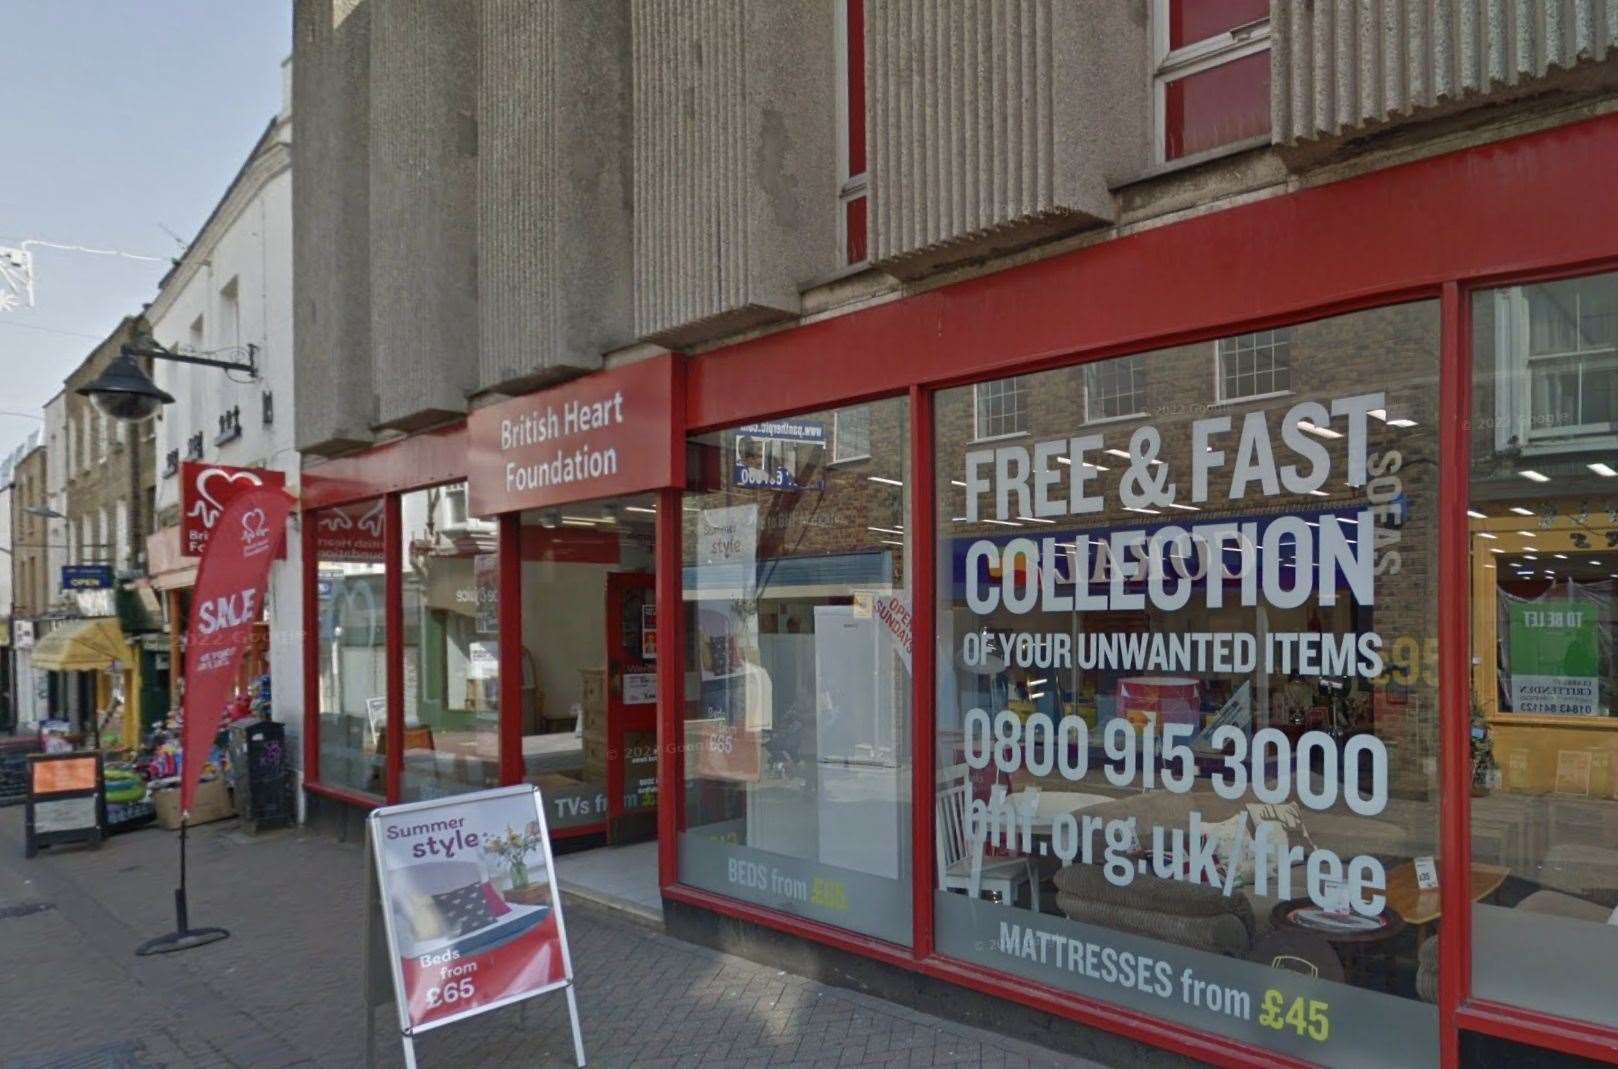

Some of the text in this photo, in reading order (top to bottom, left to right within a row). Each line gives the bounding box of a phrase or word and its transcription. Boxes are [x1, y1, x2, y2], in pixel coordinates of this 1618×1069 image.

[501, 392, 624, 450] British Heart
[505, 447, 617, 492] Foundation
[965, 392, 1385, 523] FREE & FAST
[965, 507, 1374, 615] COLLECTION
[197, 588, 257, 634] SALE
[875, 600, 913, 654] SUNDAYS
[889, 598, 912, 628] OPE
[963, 632, 1384, 679] OF YOUR UNWANTED ITEMS
[964, 707, 1388, 816] 0800 915 3000
[387, 817, 465, 840] Summer
[554, 796, 591, 819] TVs
[413, 830, 480, 858] style
[964, 783, 1386, 917] bhf.org.uk/free
[728, 858, 769, 891] BEDS
[771, 868, 807, 902] from
[420, 950, 461, 969] Beds
[440, 960, 477, 980] from
[1000, 921, 1330, 1042] MATTRESSES from £45
[425, 977, 475, 1006] £65
